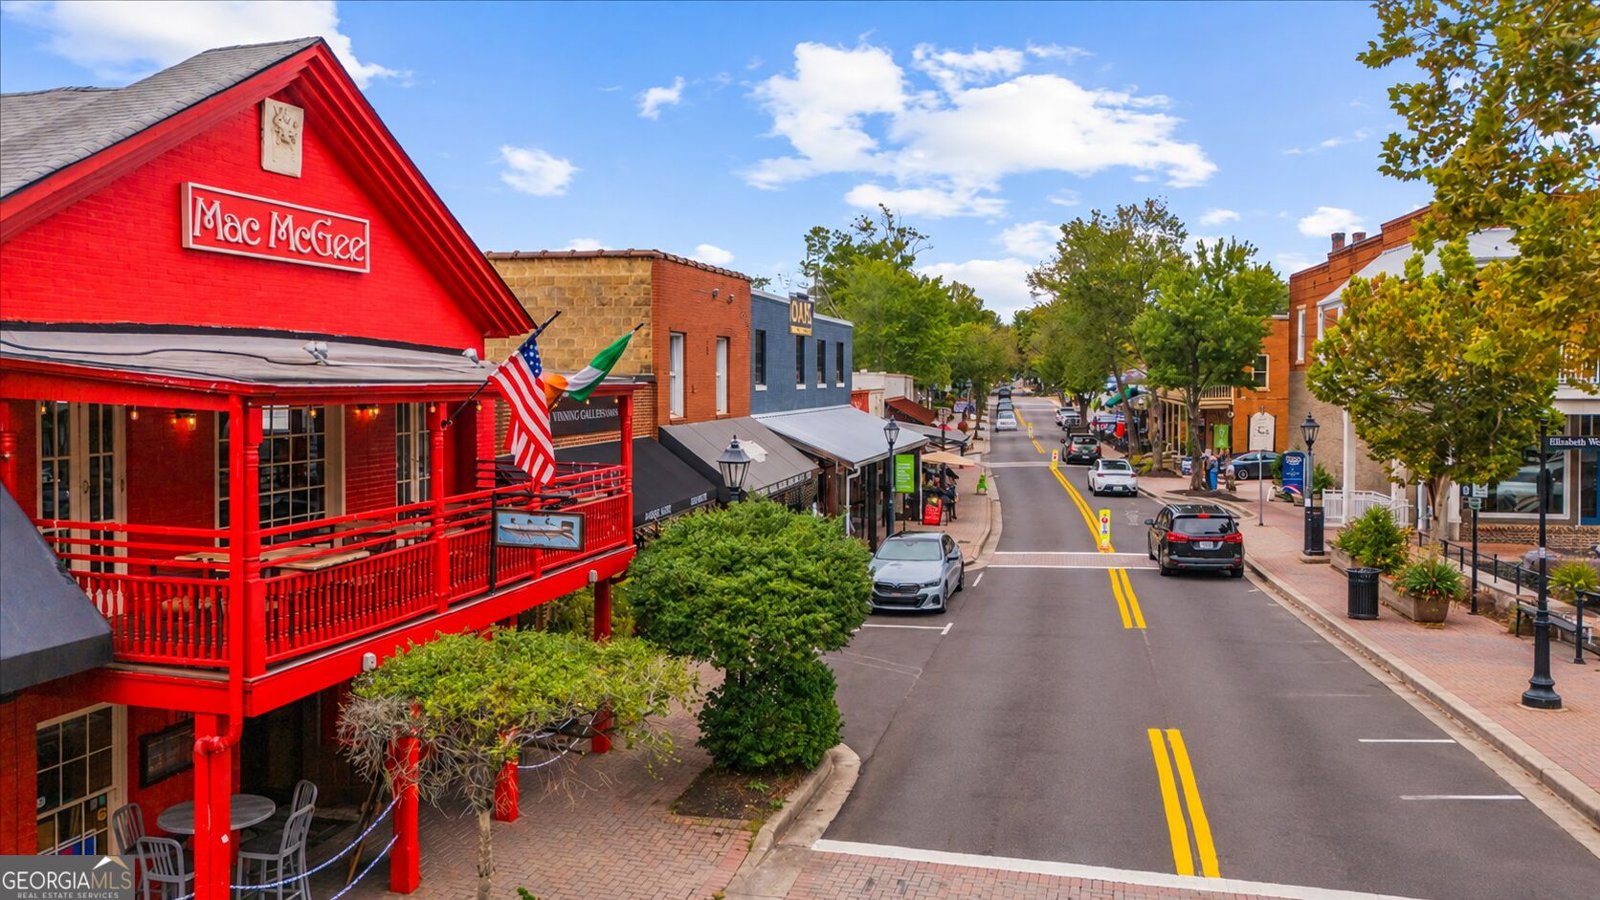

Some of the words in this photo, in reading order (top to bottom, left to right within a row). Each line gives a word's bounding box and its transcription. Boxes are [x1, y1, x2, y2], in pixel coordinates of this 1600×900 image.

[193, 196, 261, 246] Mac
[268, 210, 366, 262] McGee
[1549, 437, 1586, 446] Elizabeth
